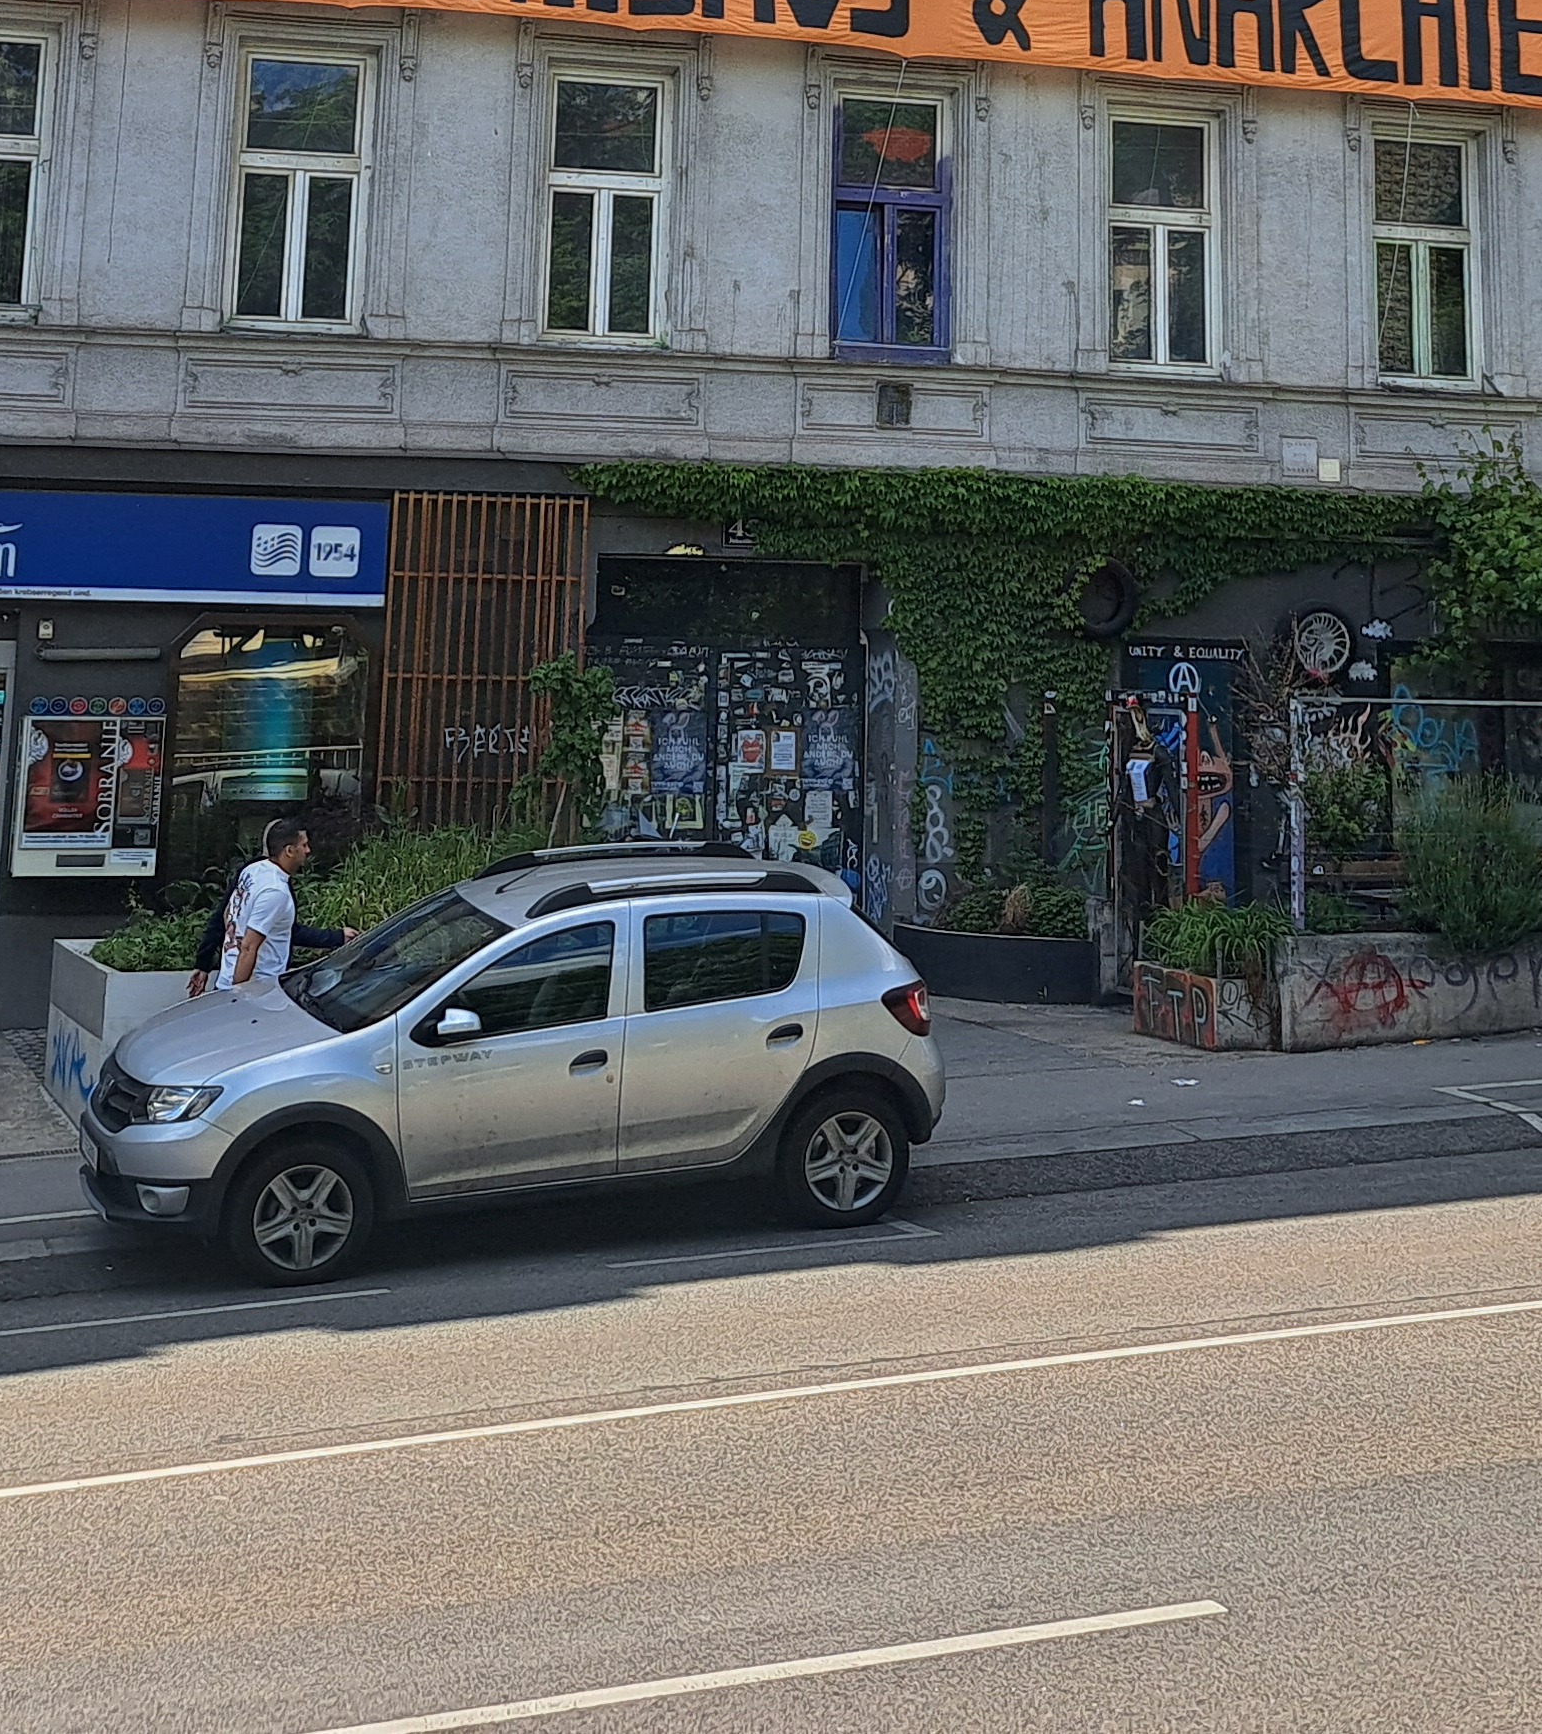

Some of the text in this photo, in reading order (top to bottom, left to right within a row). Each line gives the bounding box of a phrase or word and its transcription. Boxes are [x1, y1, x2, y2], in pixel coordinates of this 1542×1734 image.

[314, 542, 357, 561] 1954
[1128, 645, 1246, 661] UNITY & EQUALITY
[93, 721, 120, 835] SOBRANIE
[402, 1049, 493, 1070] STEPWAY
